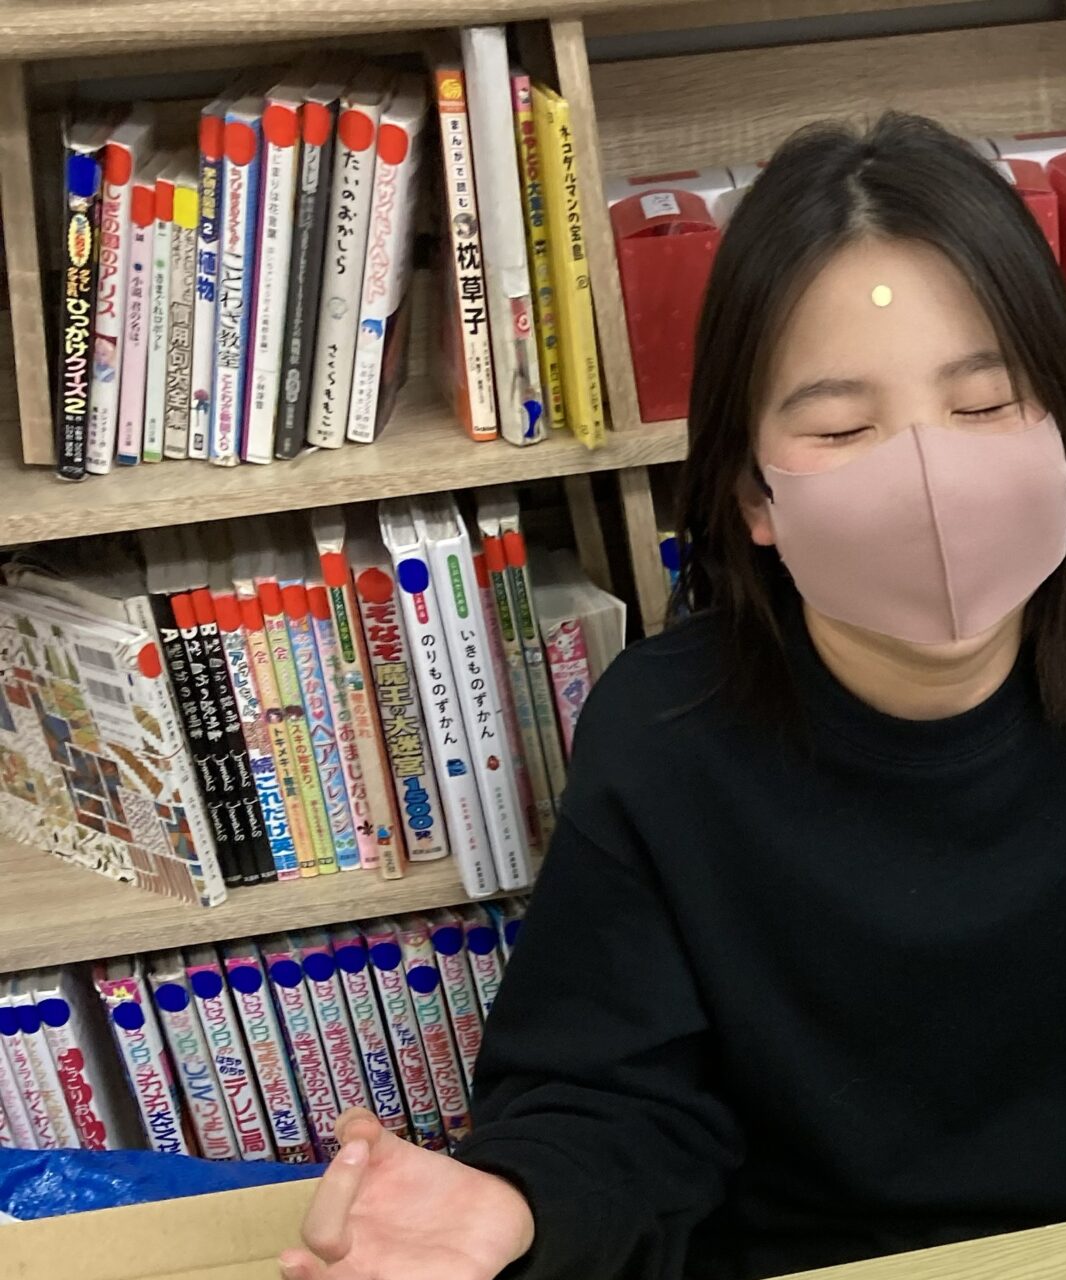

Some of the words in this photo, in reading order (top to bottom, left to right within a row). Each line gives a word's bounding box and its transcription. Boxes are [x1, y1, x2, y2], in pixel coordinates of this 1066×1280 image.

[97, 184, 121, 318] しぎの国のアリス
[336, 151, 361, 275] たいのおかしら
[196, 249, 217, 303] 植物
[217, 251, 245, 369] ことわざ教室
[456, 241, 486, 335] 枕草子
[64, 297, 91, 415] ひっかけクイズ2
[322, 343, 338, 427] さくらももこ
[421, 633, 458, 746] のりものずかん
[461, 630, 495, 740] いきものずかん
[311, 724, 350, 834] ヘアアレンジ
[338, 723, 372, 817] おまじない
[403, 775, 434, 830] 1500
[222, 1074, 266, 1156] テレビ局
